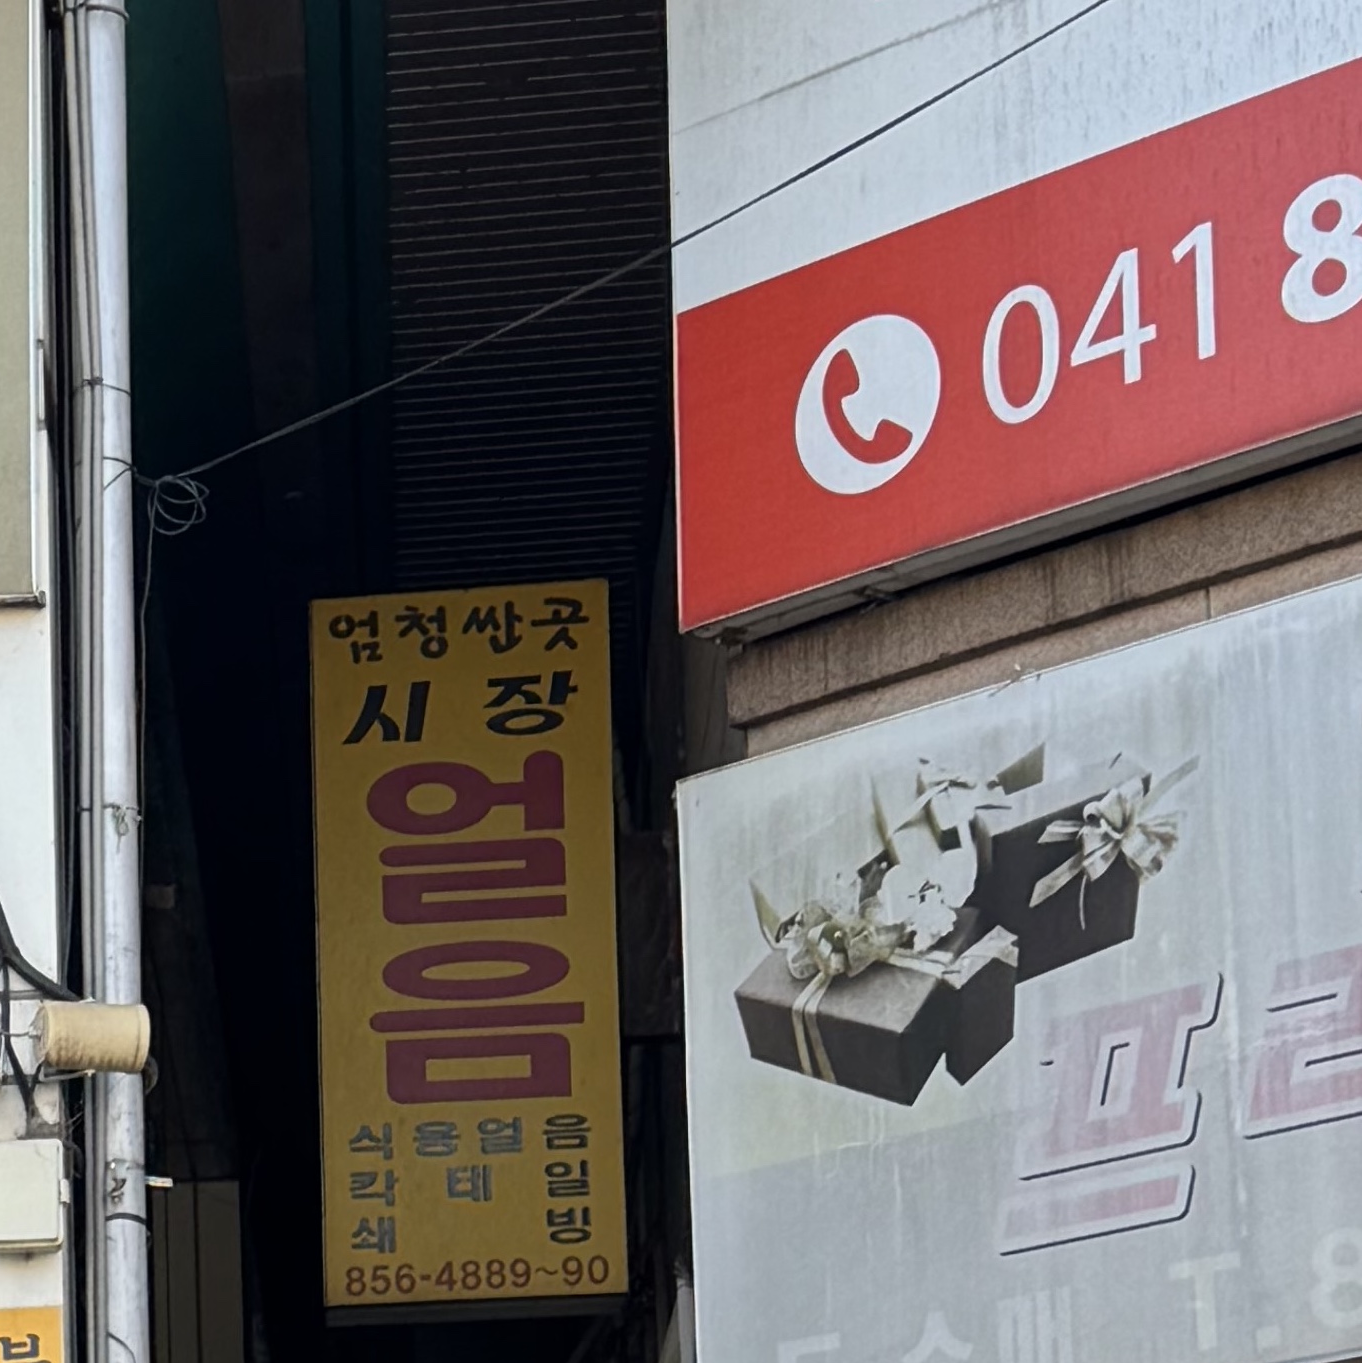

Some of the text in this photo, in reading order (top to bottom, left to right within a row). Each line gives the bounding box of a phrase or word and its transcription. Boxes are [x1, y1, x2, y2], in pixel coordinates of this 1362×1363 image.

[982, 222, 1217, 424] 041
[342, 670, 579, 745] 시장
[366, 749, 585, 1105] 얼음
